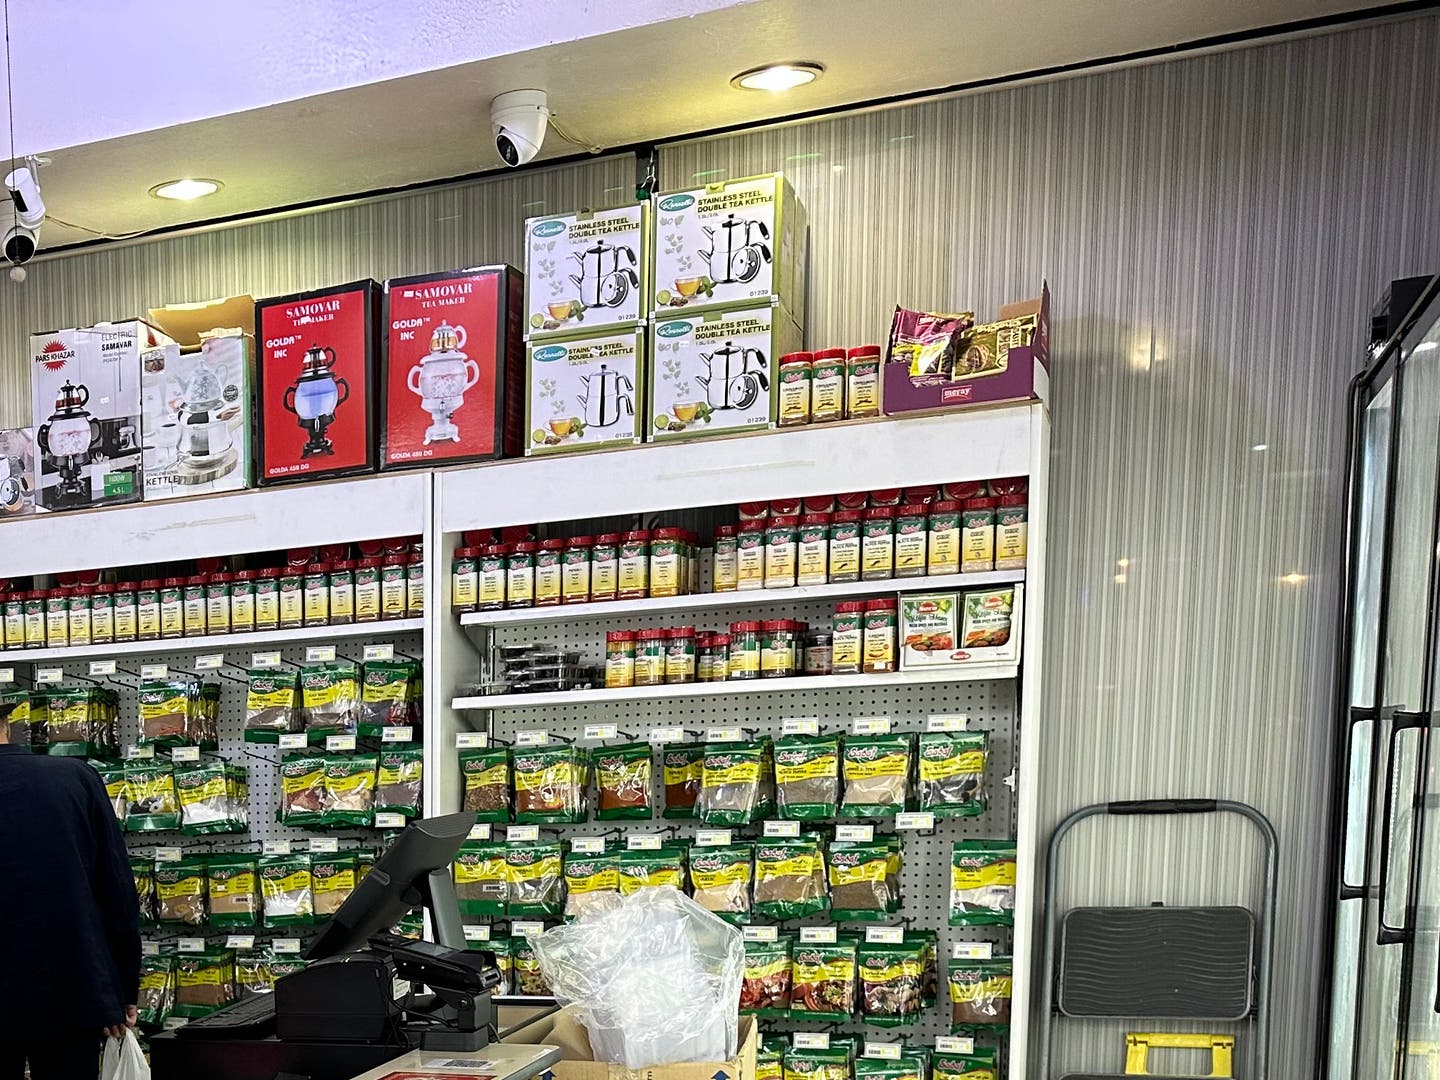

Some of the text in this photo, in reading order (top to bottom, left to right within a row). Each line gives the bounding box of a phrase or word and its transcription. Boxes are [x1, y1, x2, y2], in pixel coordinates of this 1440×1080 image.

[698, 190, 761, 206] STAINLESS STEEL
[698, 195, 773, 214] DOUBLE TEA KETTLE
[569, 217, 629, 232] STAINLESS STEEL
[569, 222, 640, 240] DOUBLE TEA KETTLE
[414, 282, 472, 300] SAMOVAR
[422, 296, 465, 308] TEA MAKER
[286, 300, 340, 318] SAMOVAR
[696, 319, 760, 334] STAINLESS STEEL
[696, 324, 770, 340] DOUBLE TEA KETTLE
[400, 331, 415, 341] INC
[101, 340, 132, 351] SAMAVAR
[603, 342, 624, 350] STEEL
[35, 354, 50, 363] PARS
[274, 350, 288, 358] INC
[608, 348, 634, 357] KETTLE
[944, 387, 971, 398] meray
[146, 476, 178, 486] KETTLE
